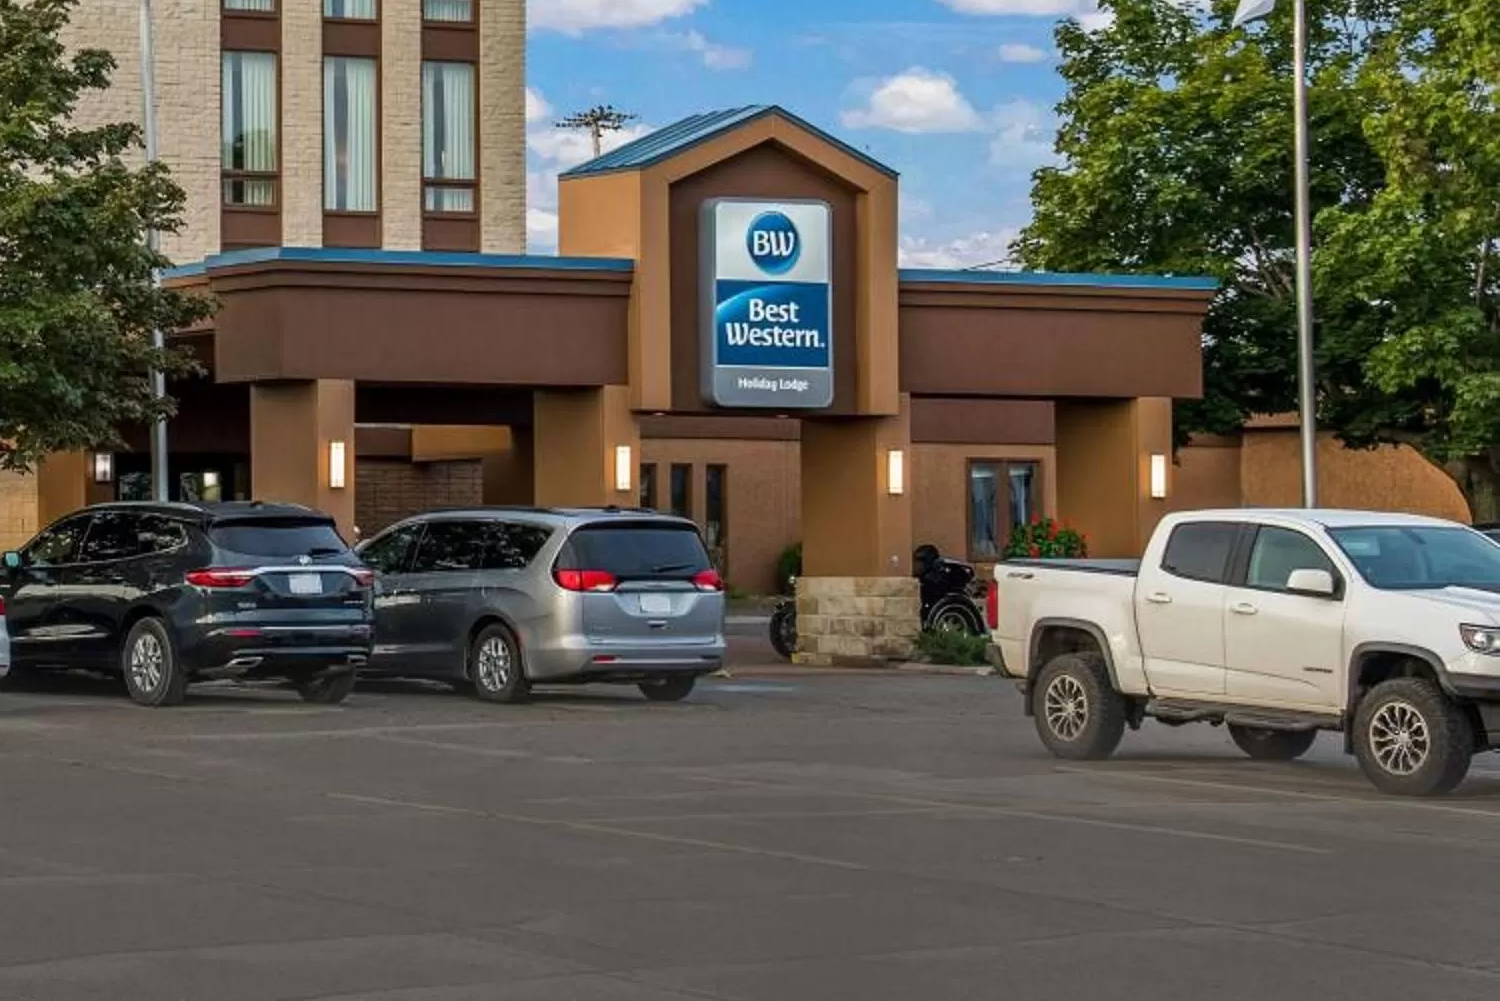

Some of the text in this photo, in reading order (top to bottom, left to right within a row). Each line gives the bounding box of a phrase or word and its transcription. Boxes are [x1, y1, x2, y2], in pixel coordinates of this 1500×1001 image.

[752, 230, 795, 257] BW
[749, 298, 800, 323] Best
[737, 377, 809, 392] Holiday Lodge
